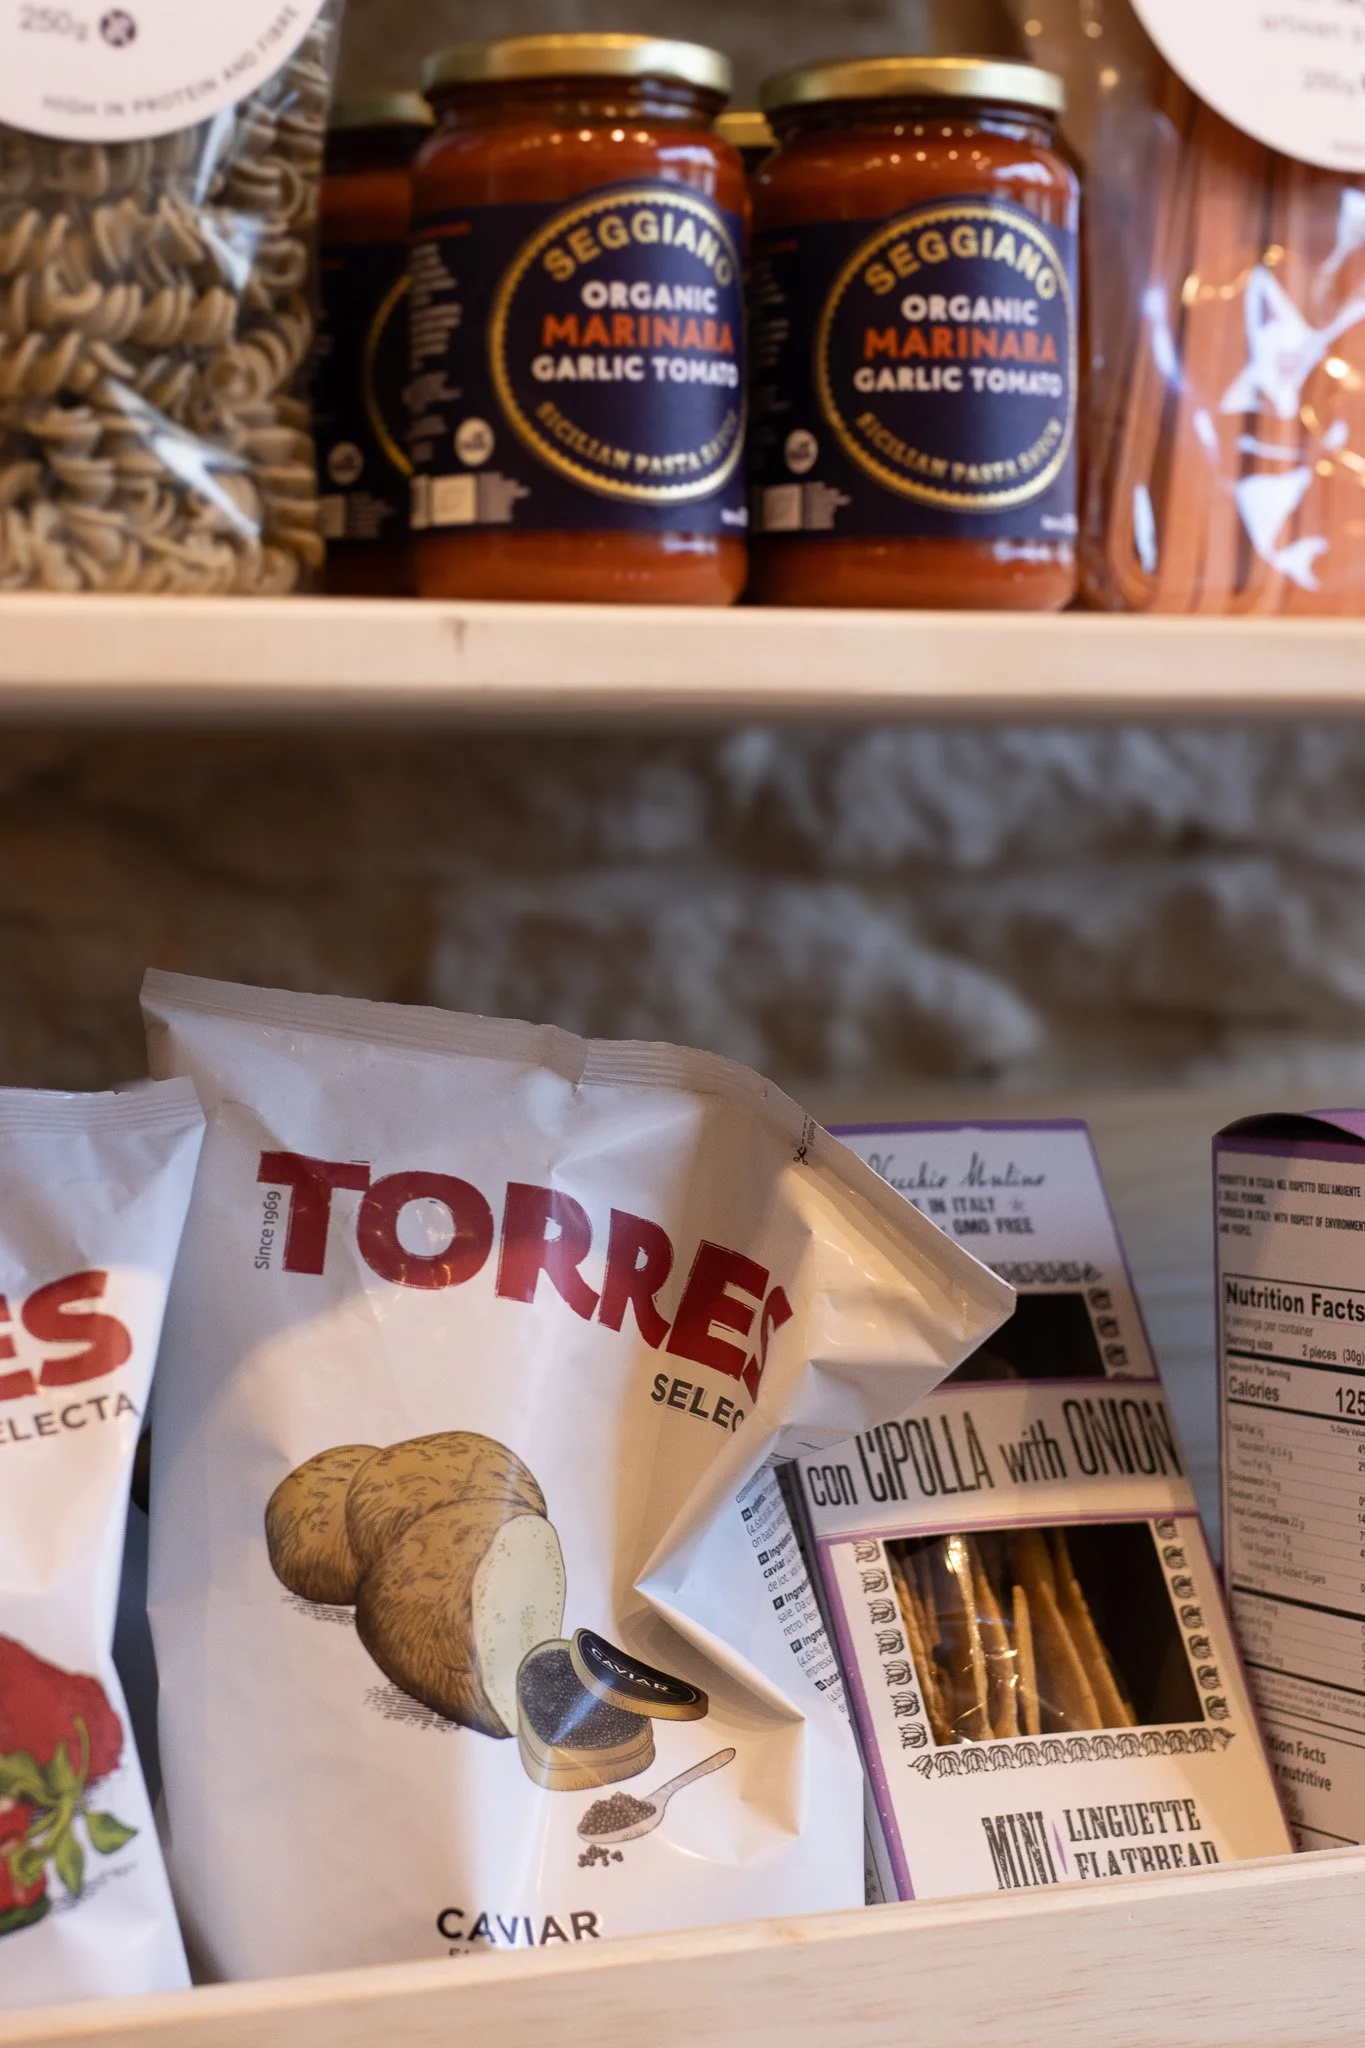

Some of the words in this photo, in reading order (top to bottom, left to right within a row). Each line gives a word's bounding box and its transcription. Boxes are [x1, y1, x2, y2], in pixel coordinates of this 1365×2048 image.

[543, 211, 732, 286] SEGGIANO
[864, 225, 1058, 300] SEGGIANO
[582, 281, 718, 314] ORGANIC
[901, 294, 1039, 326] ORGANIC
[542, 314, 733, 352] MARINARA
[864, 326, 1058, 365] MARINARA
[532, 356, 645, 381] GARLIC
[652, 357, 738, 387] TOMATO
[854, 367, 963, 393] GARLIC
[969, 367, 1062, 398] TOMATO
[634, 452, 702, 476] PASTA
[951, 459, 1019, 483] PASTA
[263, 1190, 281, 1225] 1969
[928, 1198, 947, 1213] IN
[952, 1196, 995, 1213] ITALY
[953, 1217, 991, 1235] GMO
[996, 1216, 1035, 1235] FREE
[254, 1228, 275, 1271] Since
[257, 1150, 794, 1404] TORRES
[1226, 1281, 1304, 1315] Nutrition
[1311, 1293, 1365, 1323] Facts
[1257, 1338, 1274, 1351] size
[1278, 1322, 1314, 1338] container
[1302, 1344, 1308, 1357] 2
[1309, 1345, 1338, 1361] pieces
[1342, 1348, 1365, 1367] (30g)
[1229, 1375, 1280, 1402] Calories
[1335, 1386, 1365, 1416] 125
[807, 1465, 859, 1507] con
[856, 1411, 995, 1503] CIPOLLA
[999, 1418, 1068, 1484] with
[1062, 1397, 1184, 1479] ONION
[763, 1558, 786, 1579] caviar
[767, 1580, 779, 1592] de
[591, 1647, 669, 1692] CAVIAR
[1297, 1741, 1327, 1764] Facts
[1282, 1765, 1332, 1791] nutritive
[981, 1811, 1060, 1890] MINI
[1062, 1798, 1202, 1842] LINGUETTE
[1073, 1840, 1220, 1880] FLATBREAD
[436, 1906, 600, 1946] CAVIAR
